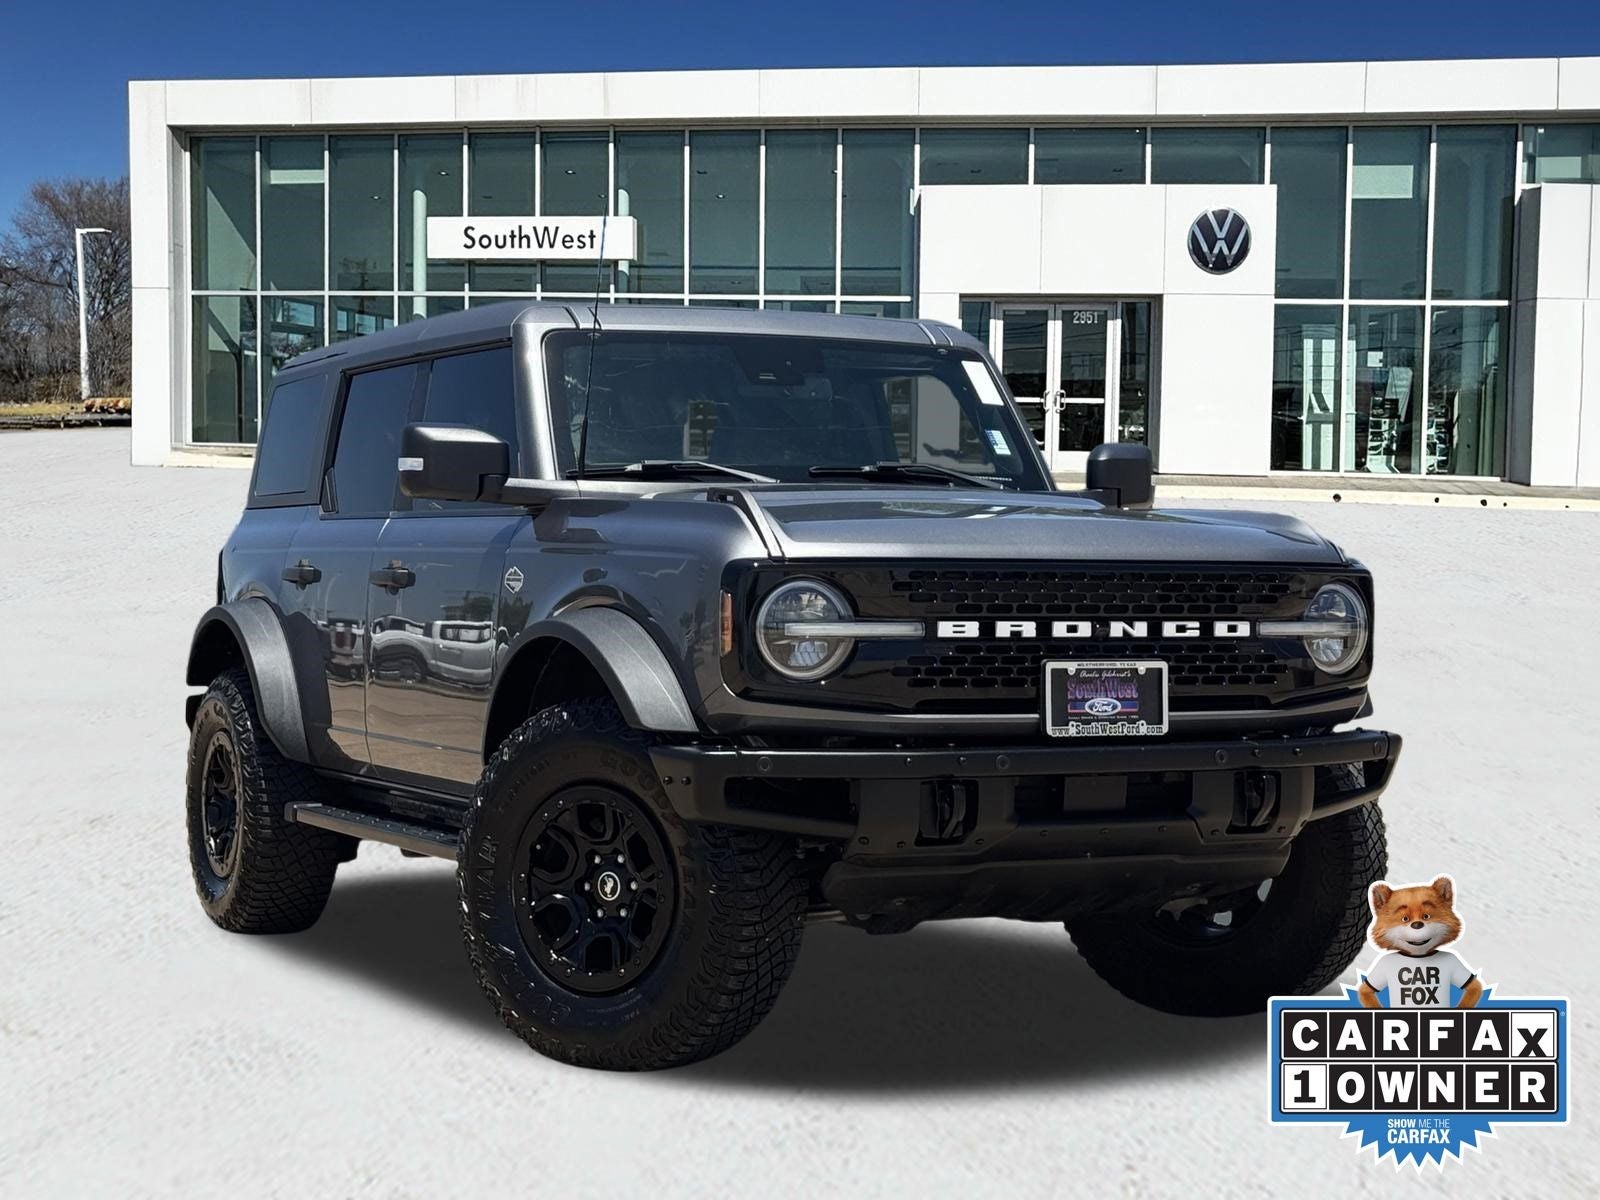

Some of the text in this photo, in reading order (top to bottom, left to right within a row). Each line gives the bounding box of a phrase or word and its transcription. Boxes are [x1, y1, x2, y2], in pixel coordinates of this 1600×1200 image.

[462, 225, 597, 250] SouthWest
[1072, 311, 1098, 324] 2951
[936, 620, 1251, 638] BRONCO
[1091, 701, 1114, 712] Ford
